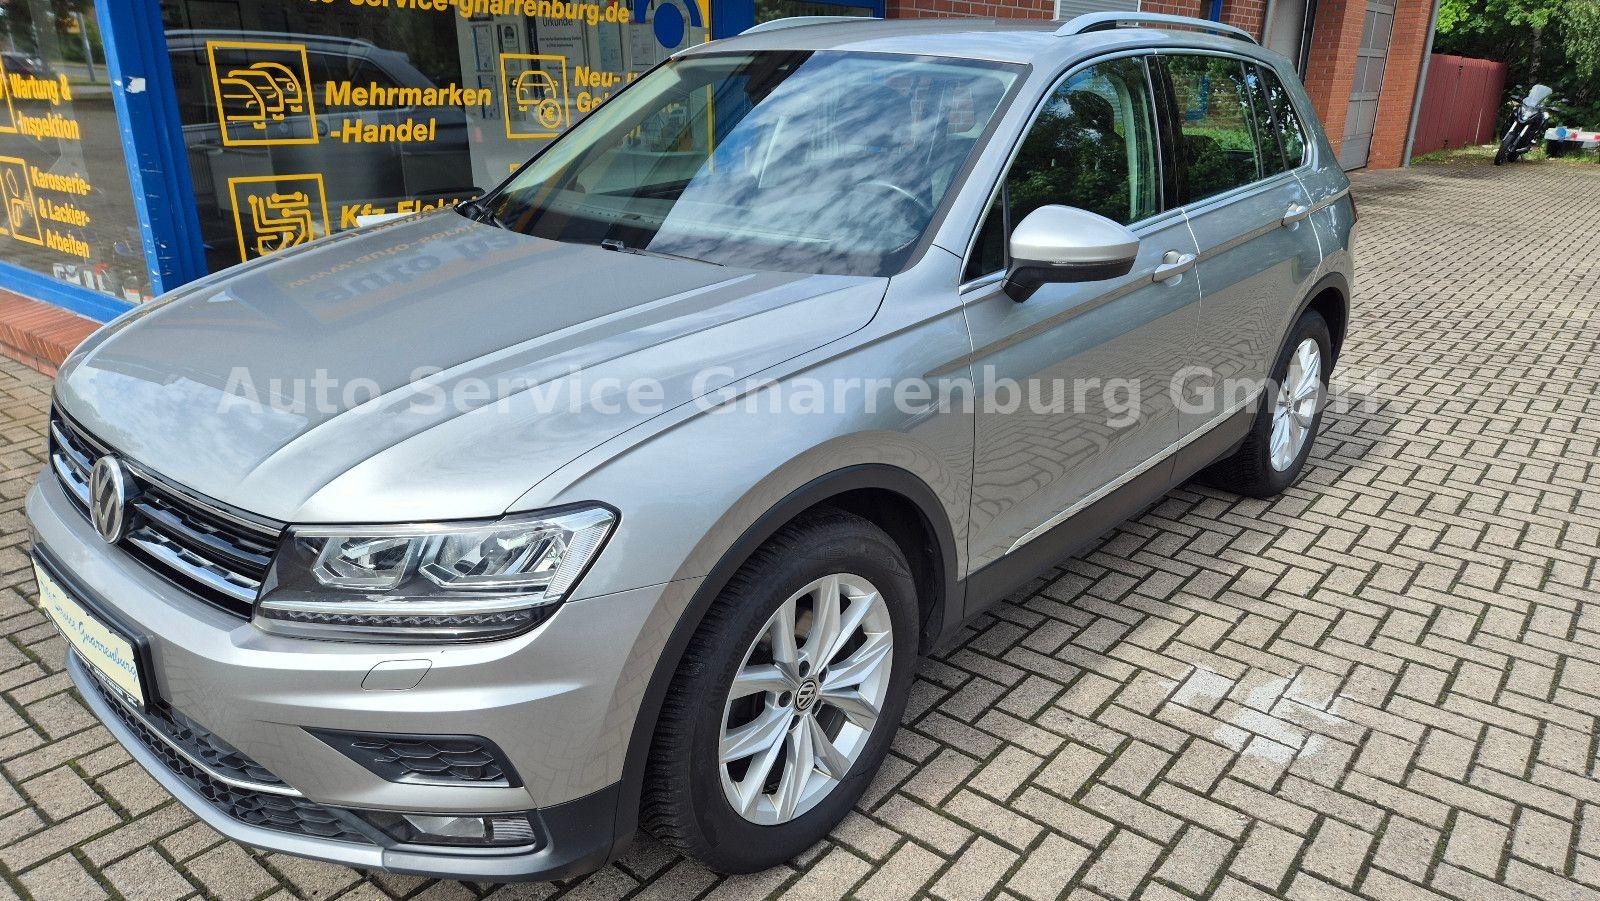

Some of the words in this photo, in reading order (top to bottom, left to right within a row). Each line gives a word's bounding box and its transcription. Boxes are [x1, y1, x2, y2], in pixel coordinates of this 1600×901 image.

[8, 73, 59, 106] Wartung
[60, 72, 72, 101] &
[574, 65, 621, 88] Neu-
[325, 80, 492, 107] Mehrmarken
[330, 117, 436, 144] -Handel
[30, 165, 91, 196] Karosserie-
[38, 197, 47, 219] &
[47, 198, 91, 227] Lackier-
[46, 228, 90, 258] Arbeiten
